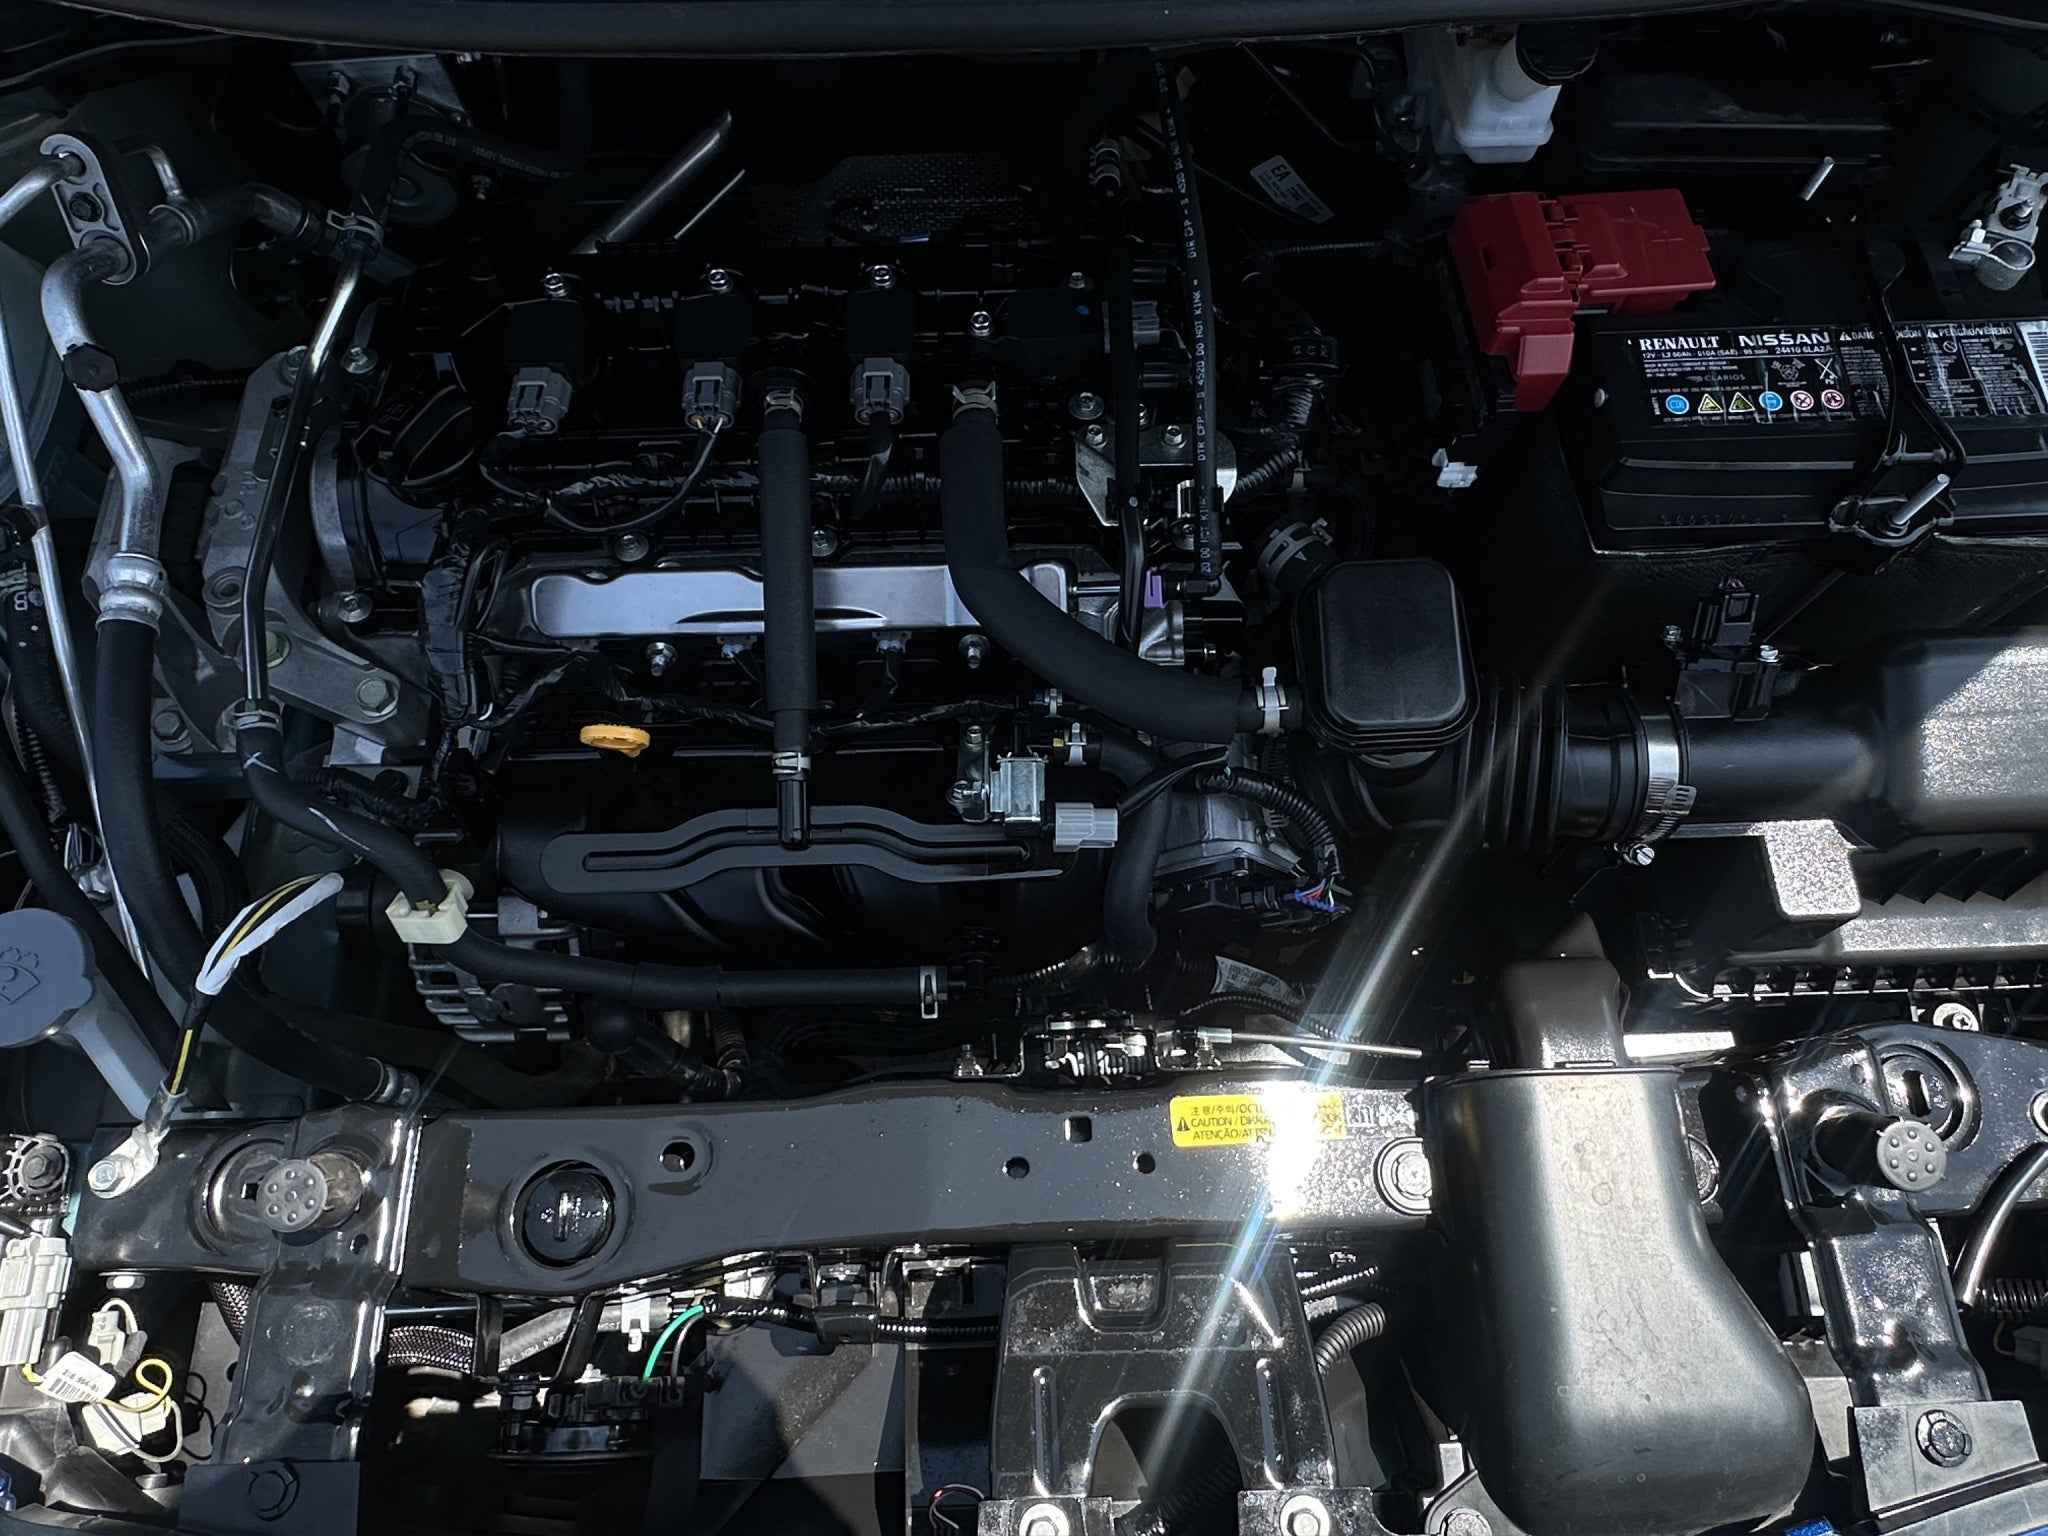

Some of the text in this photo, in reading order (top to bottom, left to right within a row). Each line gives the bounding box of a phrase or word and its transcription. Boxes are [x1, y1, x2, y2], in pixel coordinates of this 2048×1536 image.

[1270, 163, 1292, 182] EA
[1192, 290, 1203, 316] KINK
[1194, 319, 1204, 339] NOT
[1195, 342, 1205, 357] DO
[1639, 331, 1831, 351] RENAULT NISSAN
[1195, 360, 1205, 387] 4520
[1704, 373, 1746, 382] CLARIOS
[1196, 416, 1206, 437] CFP
[1197, 440, 1207, 462] DTR
[1191, 1116, 1233, 1128] CAUTION
